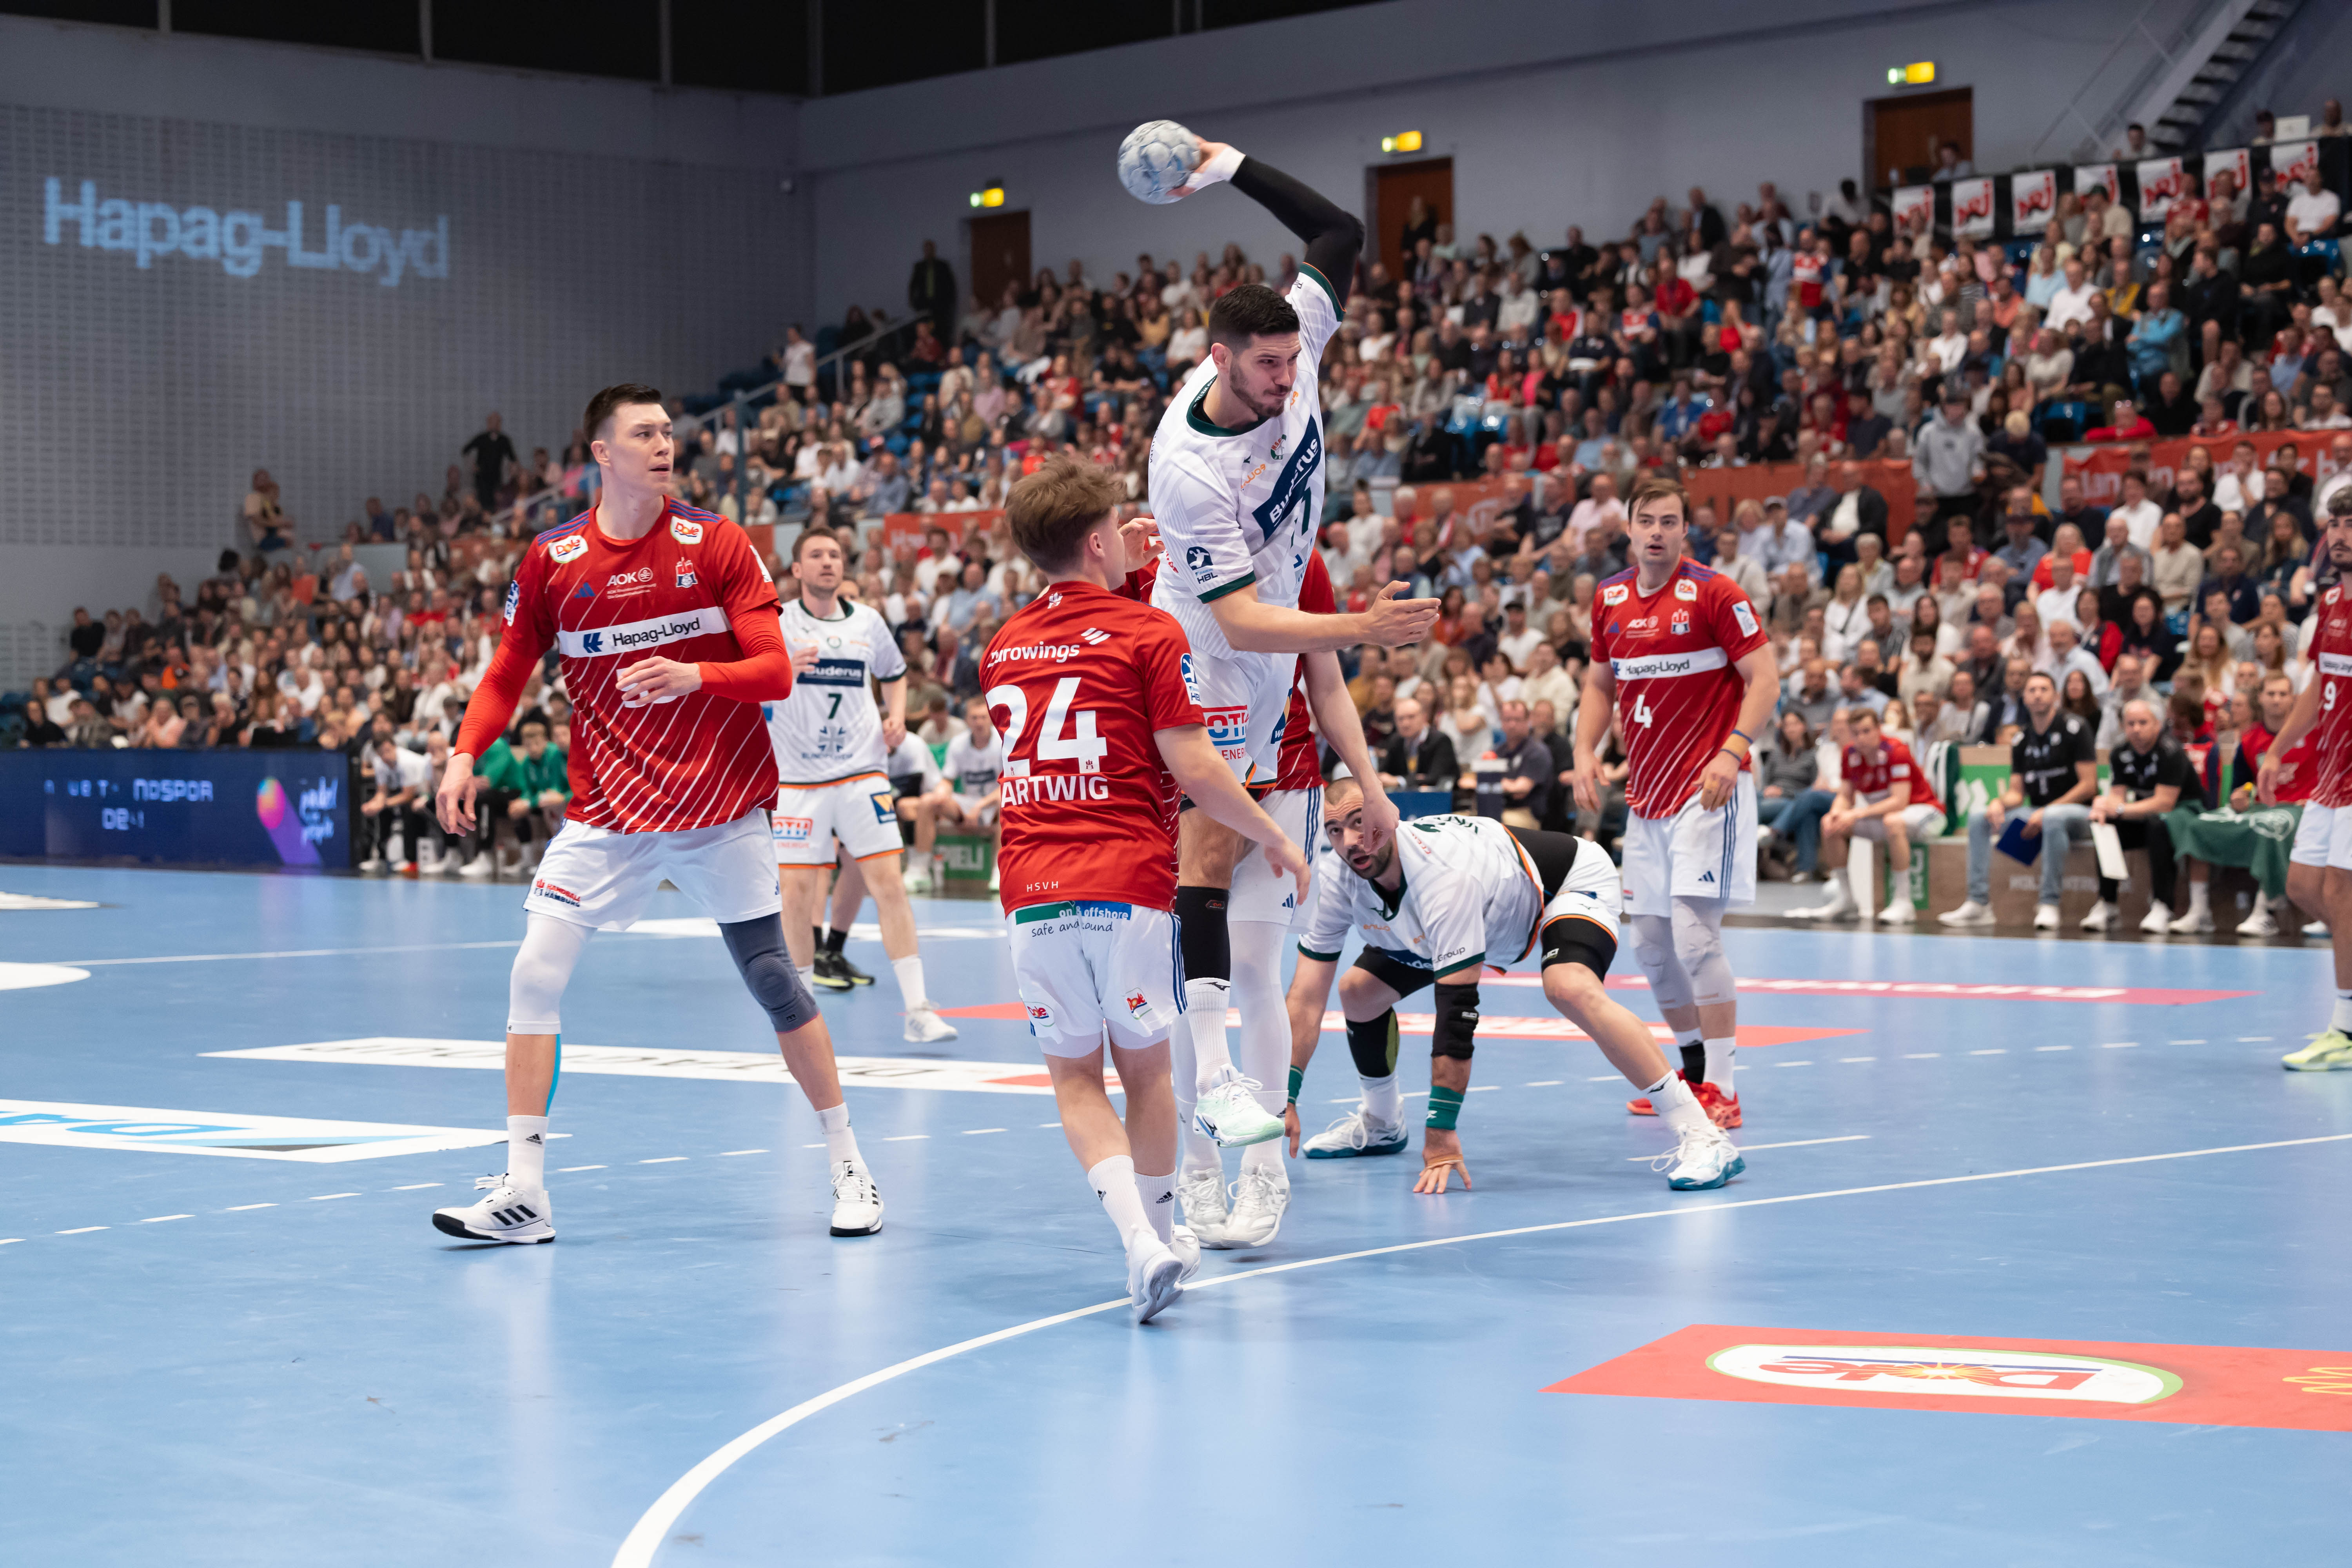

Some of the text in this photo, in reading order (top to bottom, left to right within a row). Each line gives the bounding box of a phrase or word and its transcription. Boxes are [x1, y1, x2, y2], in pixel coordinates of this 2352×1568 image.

[43, 176, 449, 287] Hapag-Lloyd
[675, 522, 700, 537] Dole
[555, 538, 581, 557] Dole
[606, 572, 638, 587] AOK
[1197, 572, 1218, 584] HBL
[612, 616, 700, 647] Hapag-Lloyd
[805, 665, 862, 677] uderus
[1626, 659, 1690, 676] Hapag-Lloyd
[2324, 681, 2336, 711] 9
[828, 693, 842, 719] 7
[1634, 694, 1652, 728] 4
[985, 677, 1107, 778] 24
[1001, 775, 1109, 808] ARTWIG
[1027, 881, 1059, 892] HSVH
[544, 891, 580, 907] HAMBURG
[1059, 908, 1073, 918] on
[1084, 906, 1129, 919] offshore
[1032, 920, 1114, 937] safe and ound
[1759, 1360, 2096, 1391] Dole
